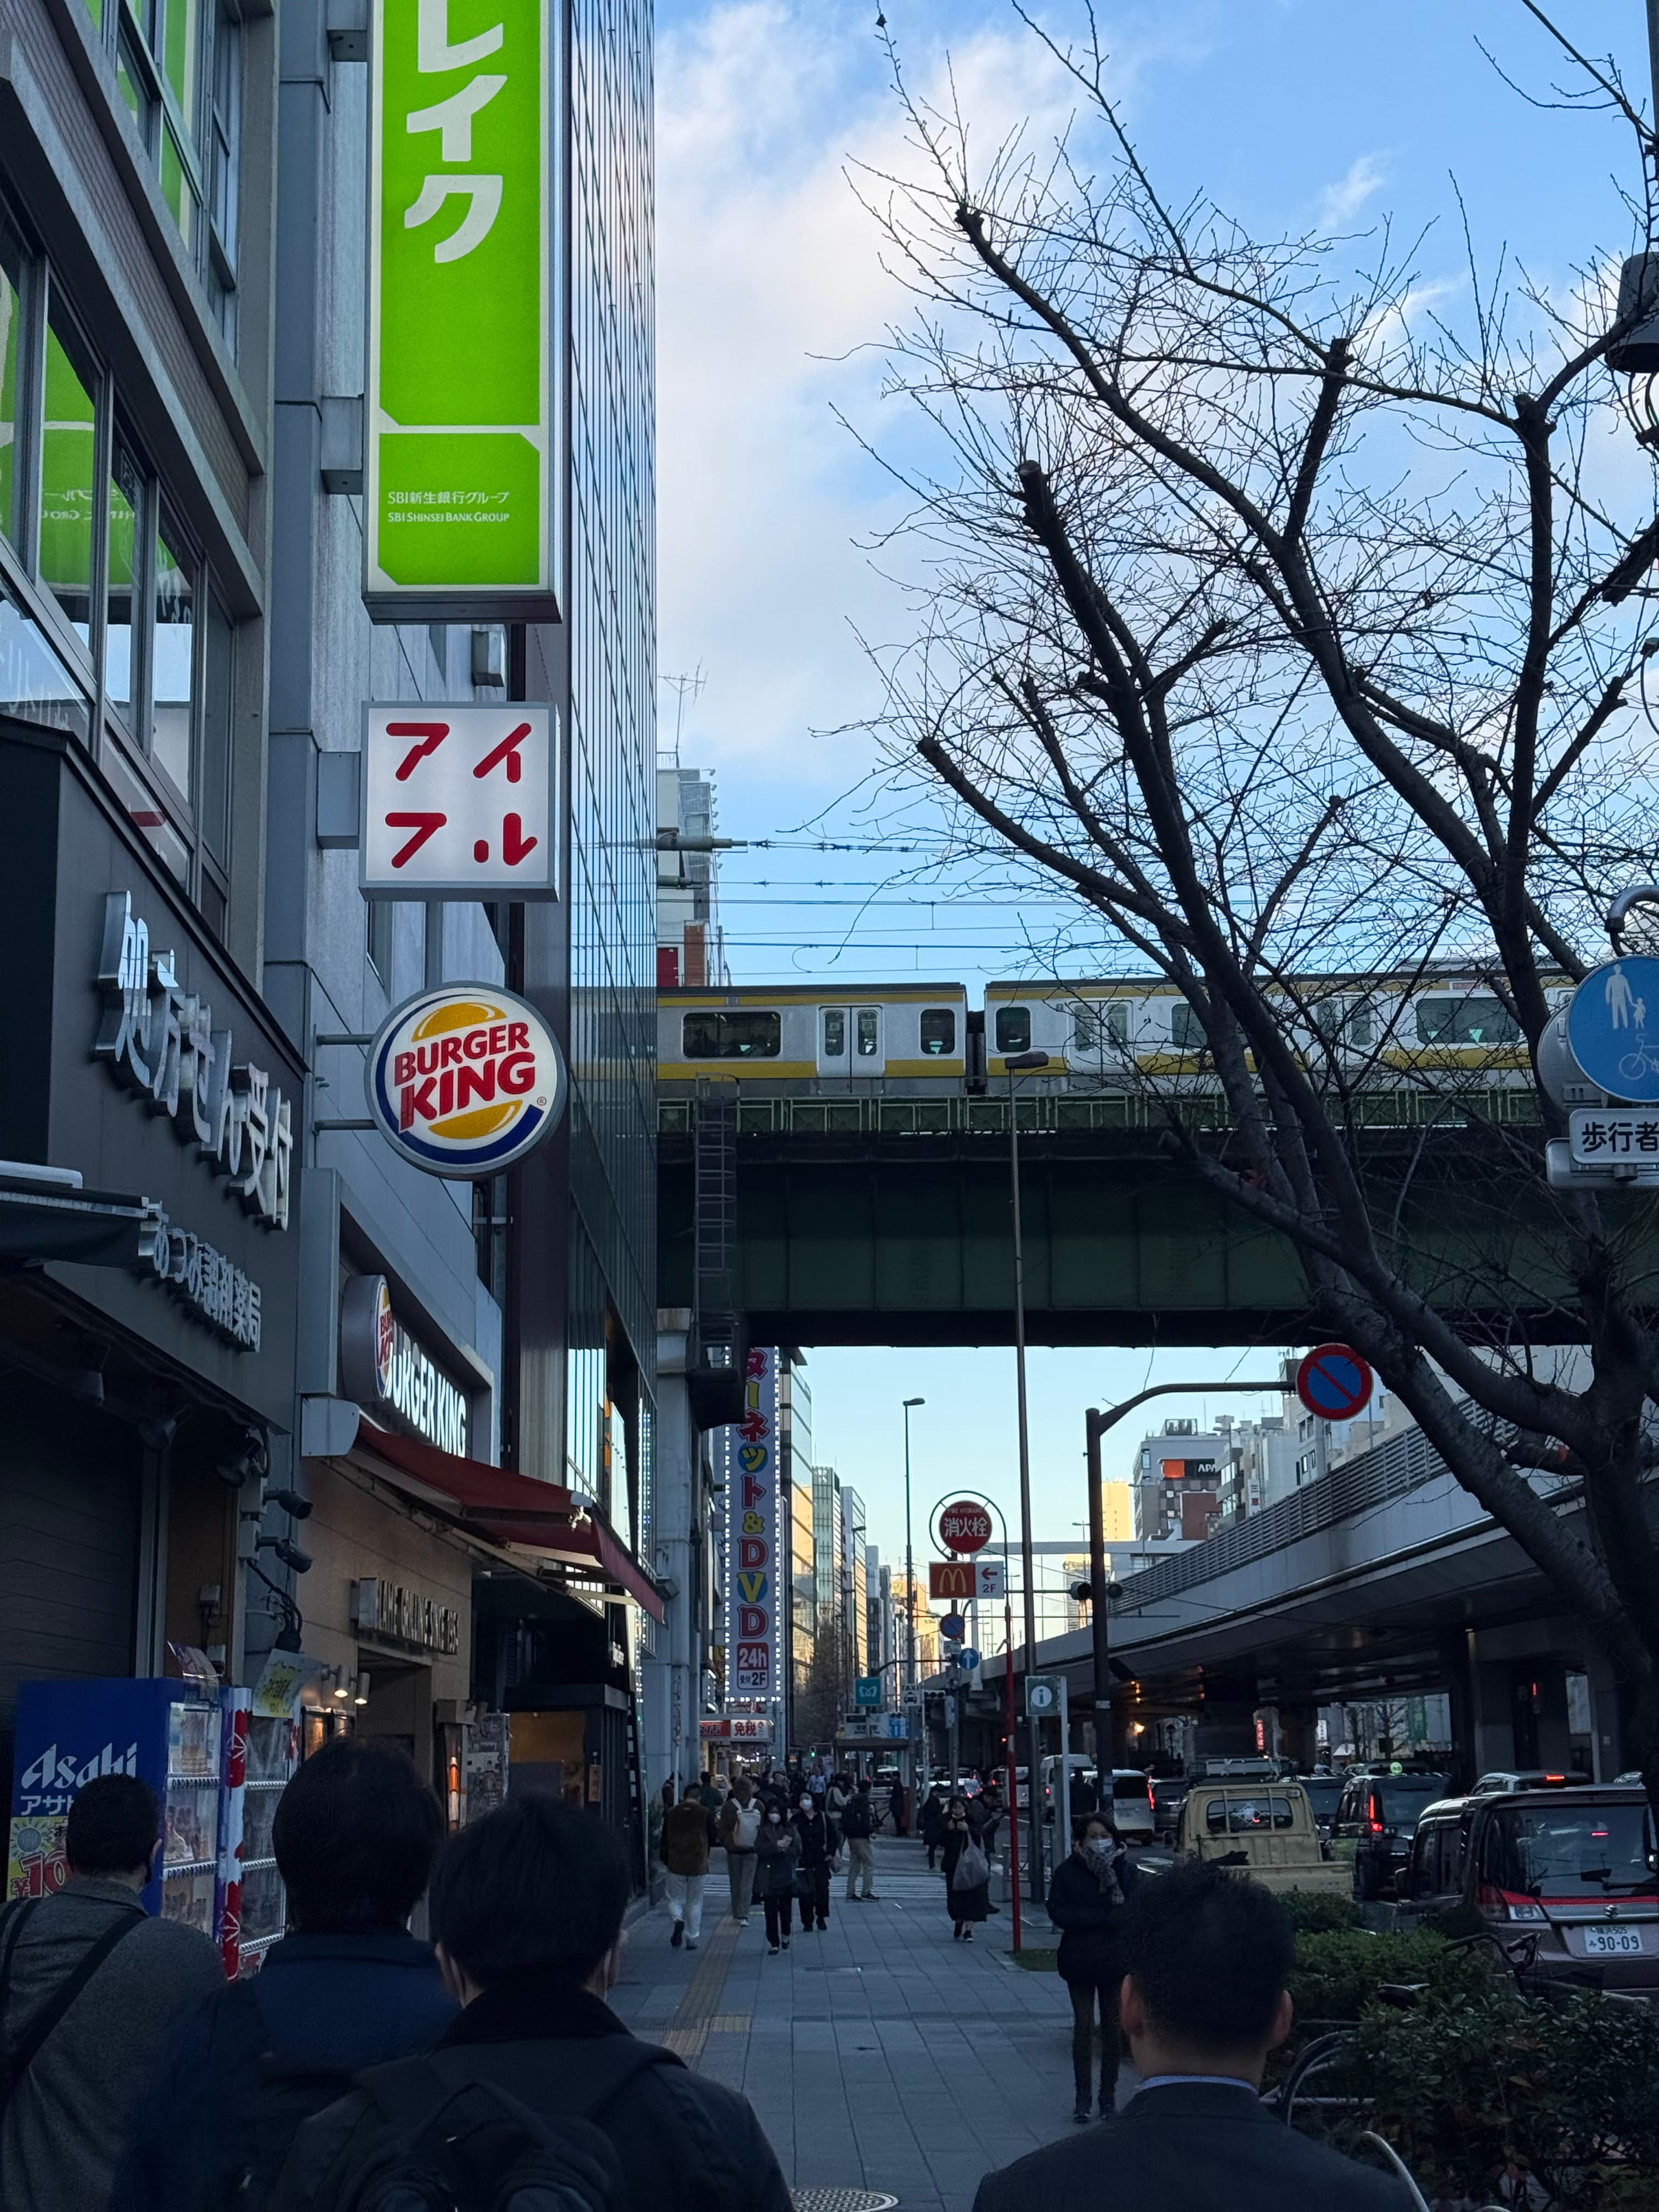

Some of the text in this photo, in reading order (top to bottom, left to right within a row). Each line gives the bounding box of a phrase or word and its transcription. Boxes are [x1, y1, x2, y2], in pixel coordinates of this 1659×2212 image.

[404, 0, 507, 263] レイク
[388, 492, 510, 504] SBI新生銀行グループ
[388, 512, 510, 522] SBI SHINSEI BANK GROUP
[115, 890, 293, 1231] 処方せん受付
[394, 1022, 530, 1086] BURGER
[400, 1052, 535, 1131] KING
[1582, 1122, 1659, 1153] 歩行者
[437, 1372, 466, 1458] KING
[944, 1517, 988, 1537] 消火栓
[983, 1584, 997, 1593] 2F
[738, 1647, 767, 1667] 24h
[734, 1720, 756, 1737] 免税
[21, 1742, 138, 1790] Asahi
[1598, 1935, 1640, 1951] 90-09
